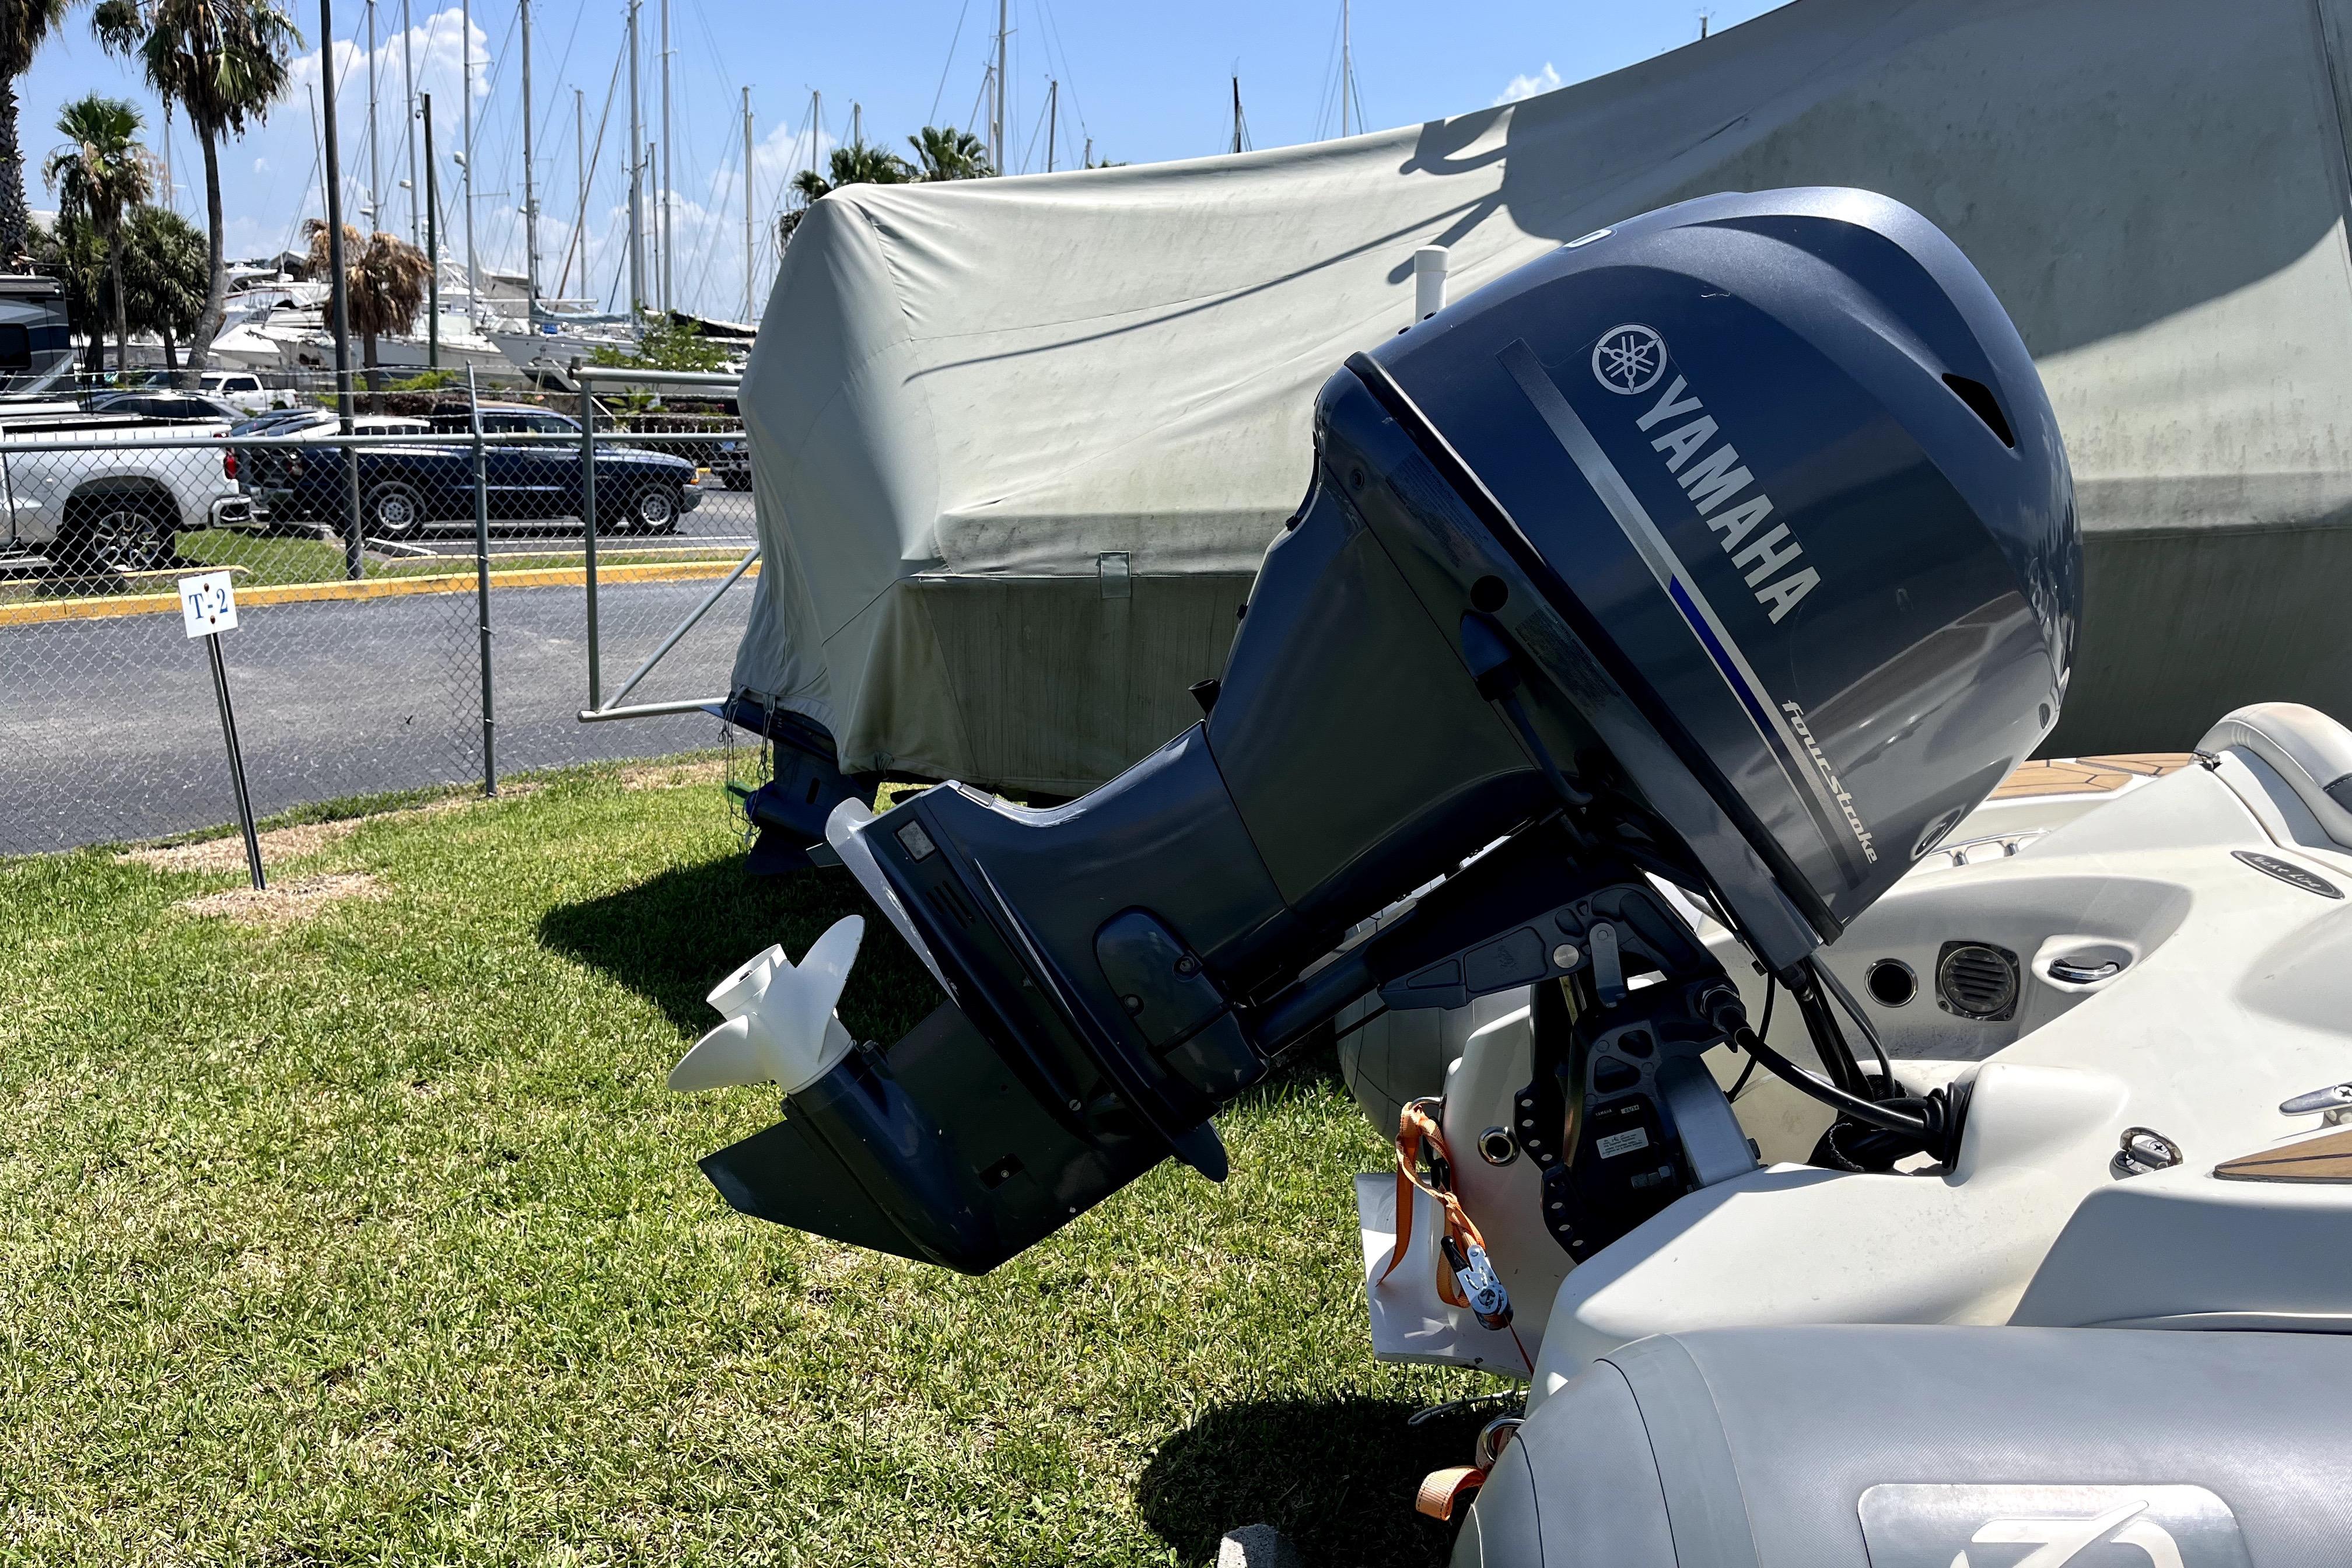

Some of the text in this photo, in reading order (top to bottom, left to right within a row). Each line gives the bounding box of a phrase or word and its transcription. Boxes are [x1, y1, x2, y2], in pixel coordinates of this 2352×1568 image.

[1634, 373, 1821, 625] YAMAHA
[188, 588, 228, 619] T-2
[2288, 874, 2321, 888] Line
